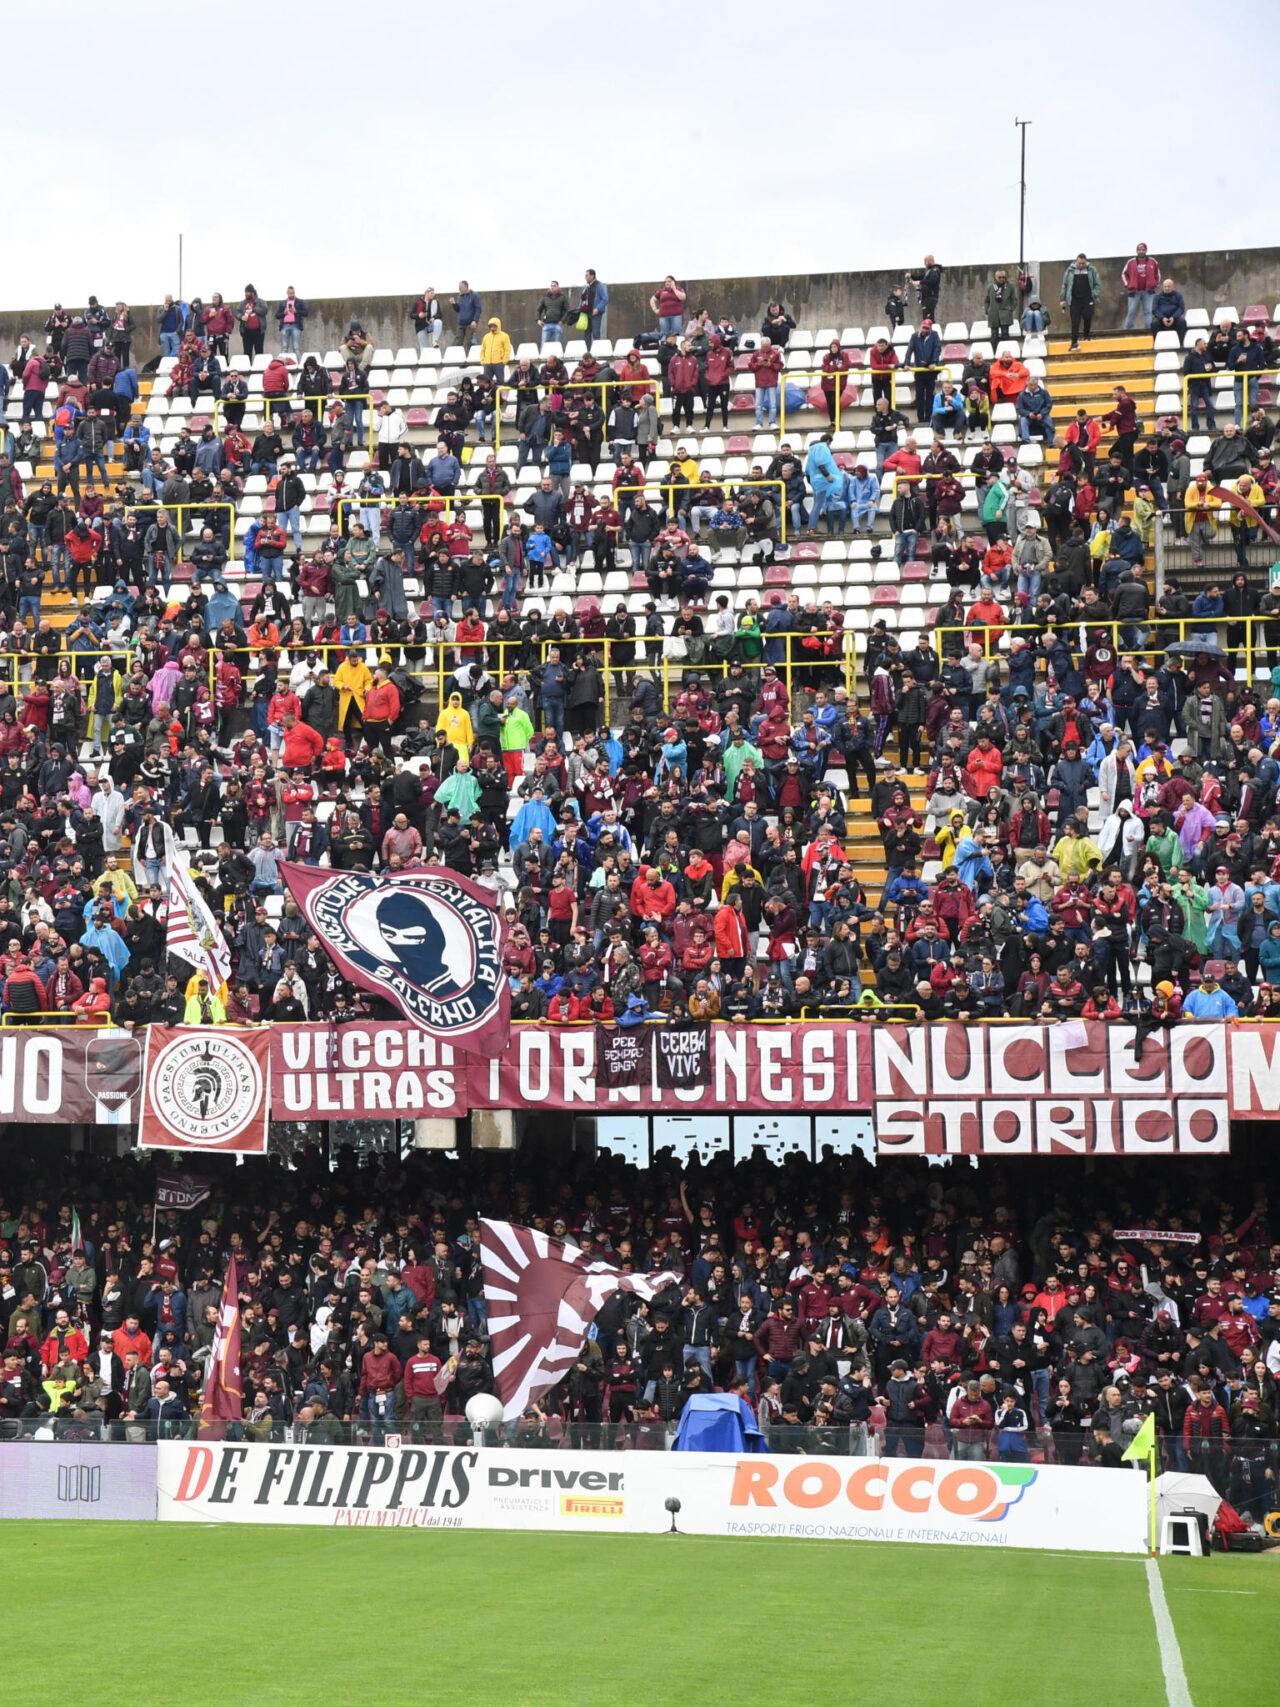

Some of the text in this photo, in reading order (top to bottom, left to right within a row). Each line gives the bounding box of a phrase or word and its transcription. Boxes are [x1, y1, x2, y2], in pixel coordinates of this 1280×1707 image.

[375, 965, 476, 1025] SALERNO
[605, 1048, 644, 1061] SEMPRE
[613, 1037, 636, 1048] PER
[660, 1029, 706, 1054] CERBA
[163, 1045, 251, 1104] PAESTUM ULTRAS
[489, 1030, 858, 1102] ORINESI
[667, 1054, 701, 1078] VIVE
[873, 1023, 1228, 1096] NUCLEO
[283, 1070, 456, 1111] ULTRAS
[170, 1112, 239, 1135] SALERNO
[877, 1096, 1229, 1154] STORICO
[174, 1446, 479, 1511] DE FILIPPIS
[729, 1460, 999, 1515] ROCCO
[332, 1507, 463, 1527] PNEUMATICI dal 1948
[565, 1498, 624, 1514] PIRELLI
[726, 1522, 1008, 1545] TRASPORTI FRIGO NAZIONALI E INTERNAZIONALI
